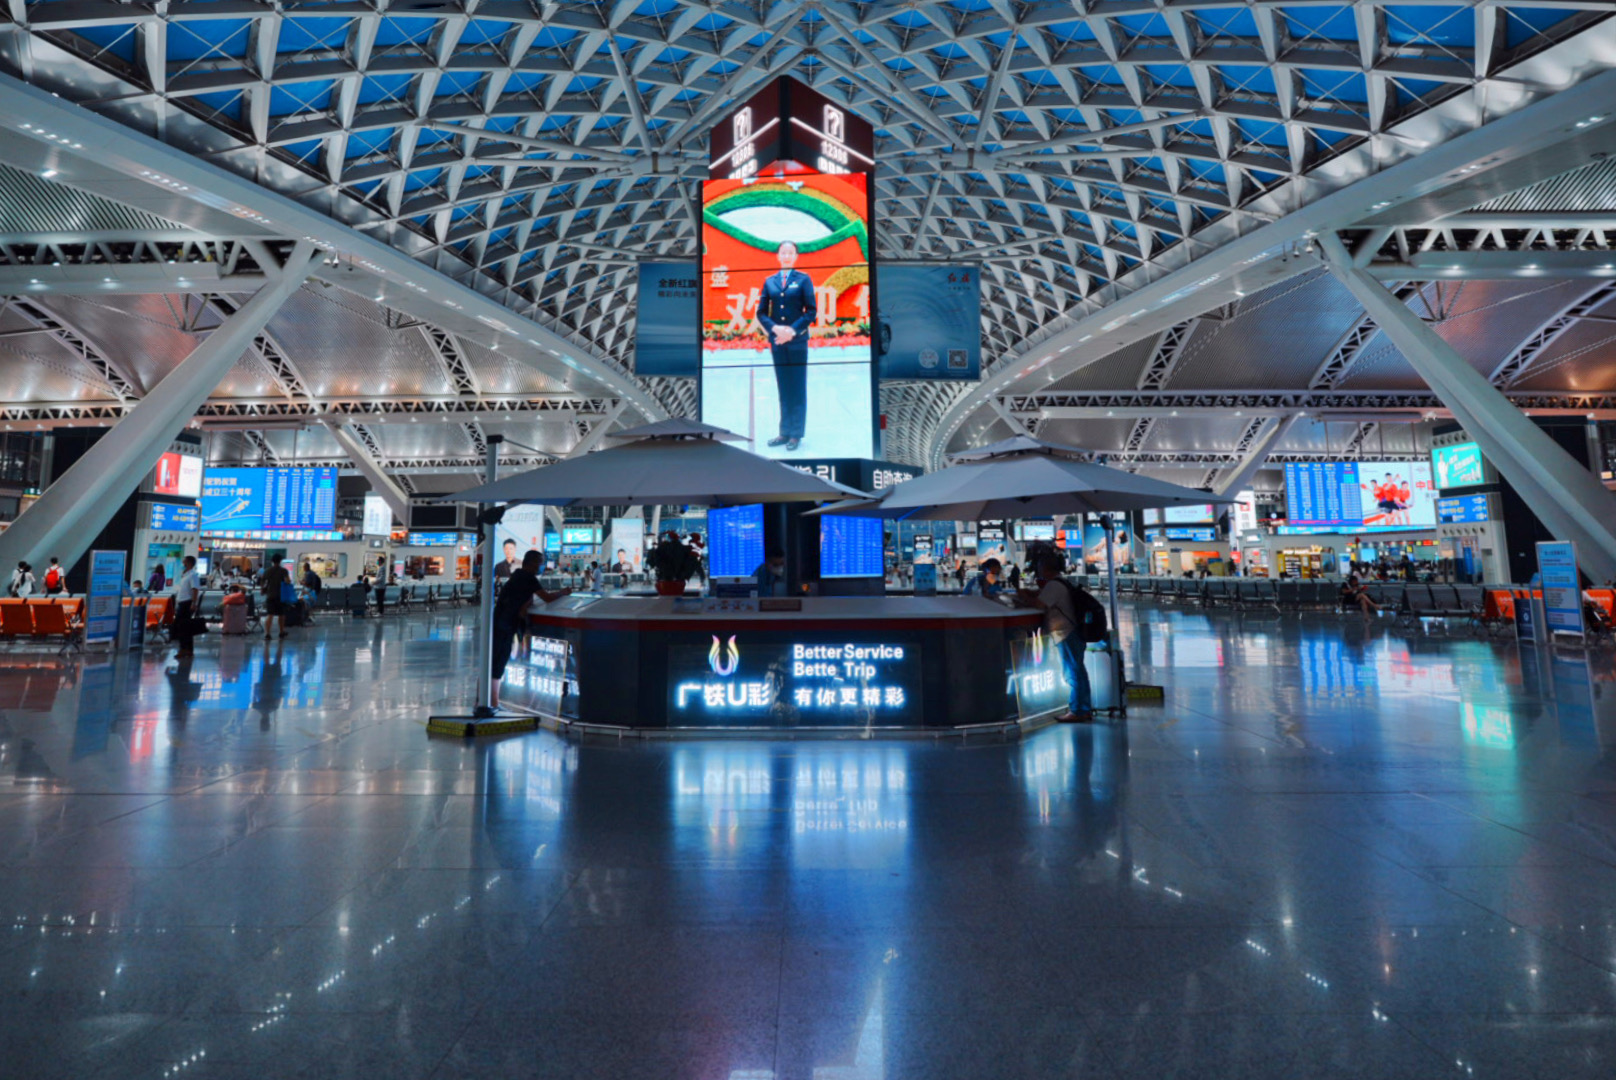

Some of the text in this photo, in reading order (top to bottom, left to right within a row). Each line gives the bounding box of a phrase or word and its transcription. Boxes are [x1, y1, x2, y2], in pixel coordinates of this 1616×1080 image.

[793, 644, 904, 660] Better Service
[843, 662, 877, 680] Trip
[677, 683, 771, 708] 广铁U彩
[794, 686, 906, 707] 有你更精彩
